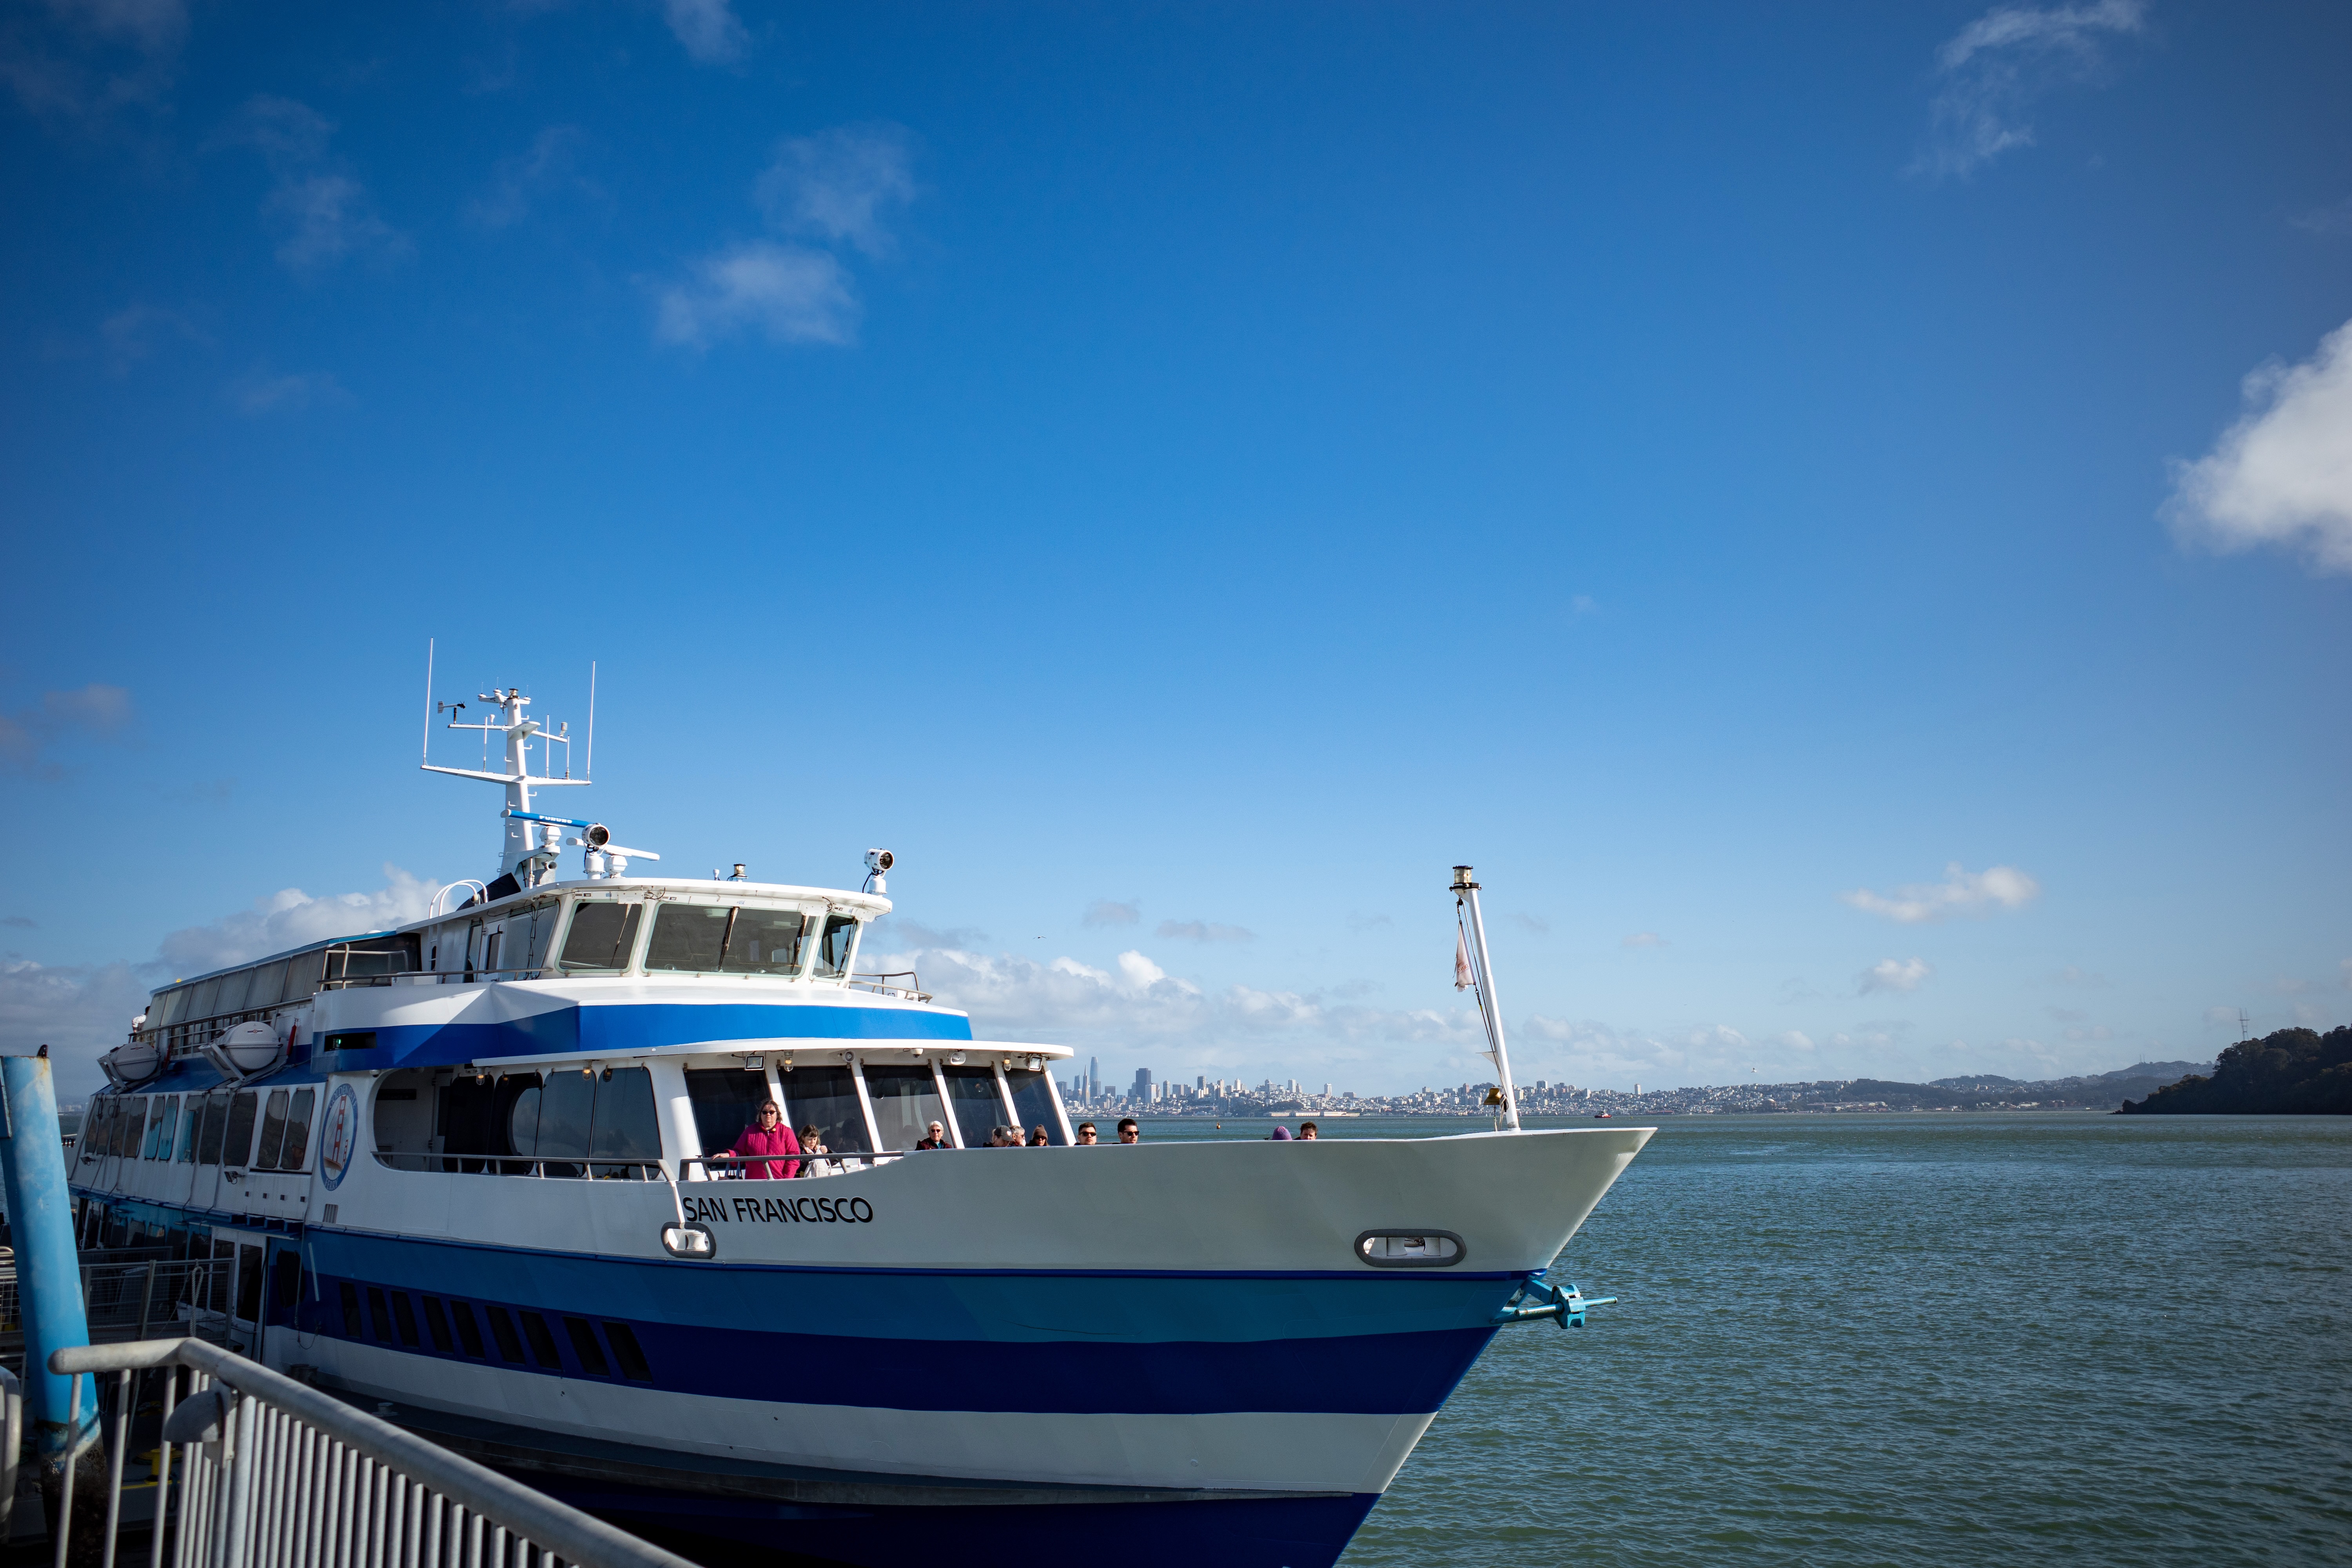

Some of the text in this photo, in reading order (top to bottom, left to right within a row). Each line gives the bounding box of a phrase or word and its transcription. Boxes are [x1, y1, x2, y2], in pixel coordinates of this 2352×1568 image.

[539, 815, 572, 824] FURUNO
[329, 1085, 357, 1108] GOLDEN GATE
[325, 1178, 338, 1190] FERRY
[683, 1197, 873, 1223] SAN FRANCISCO
